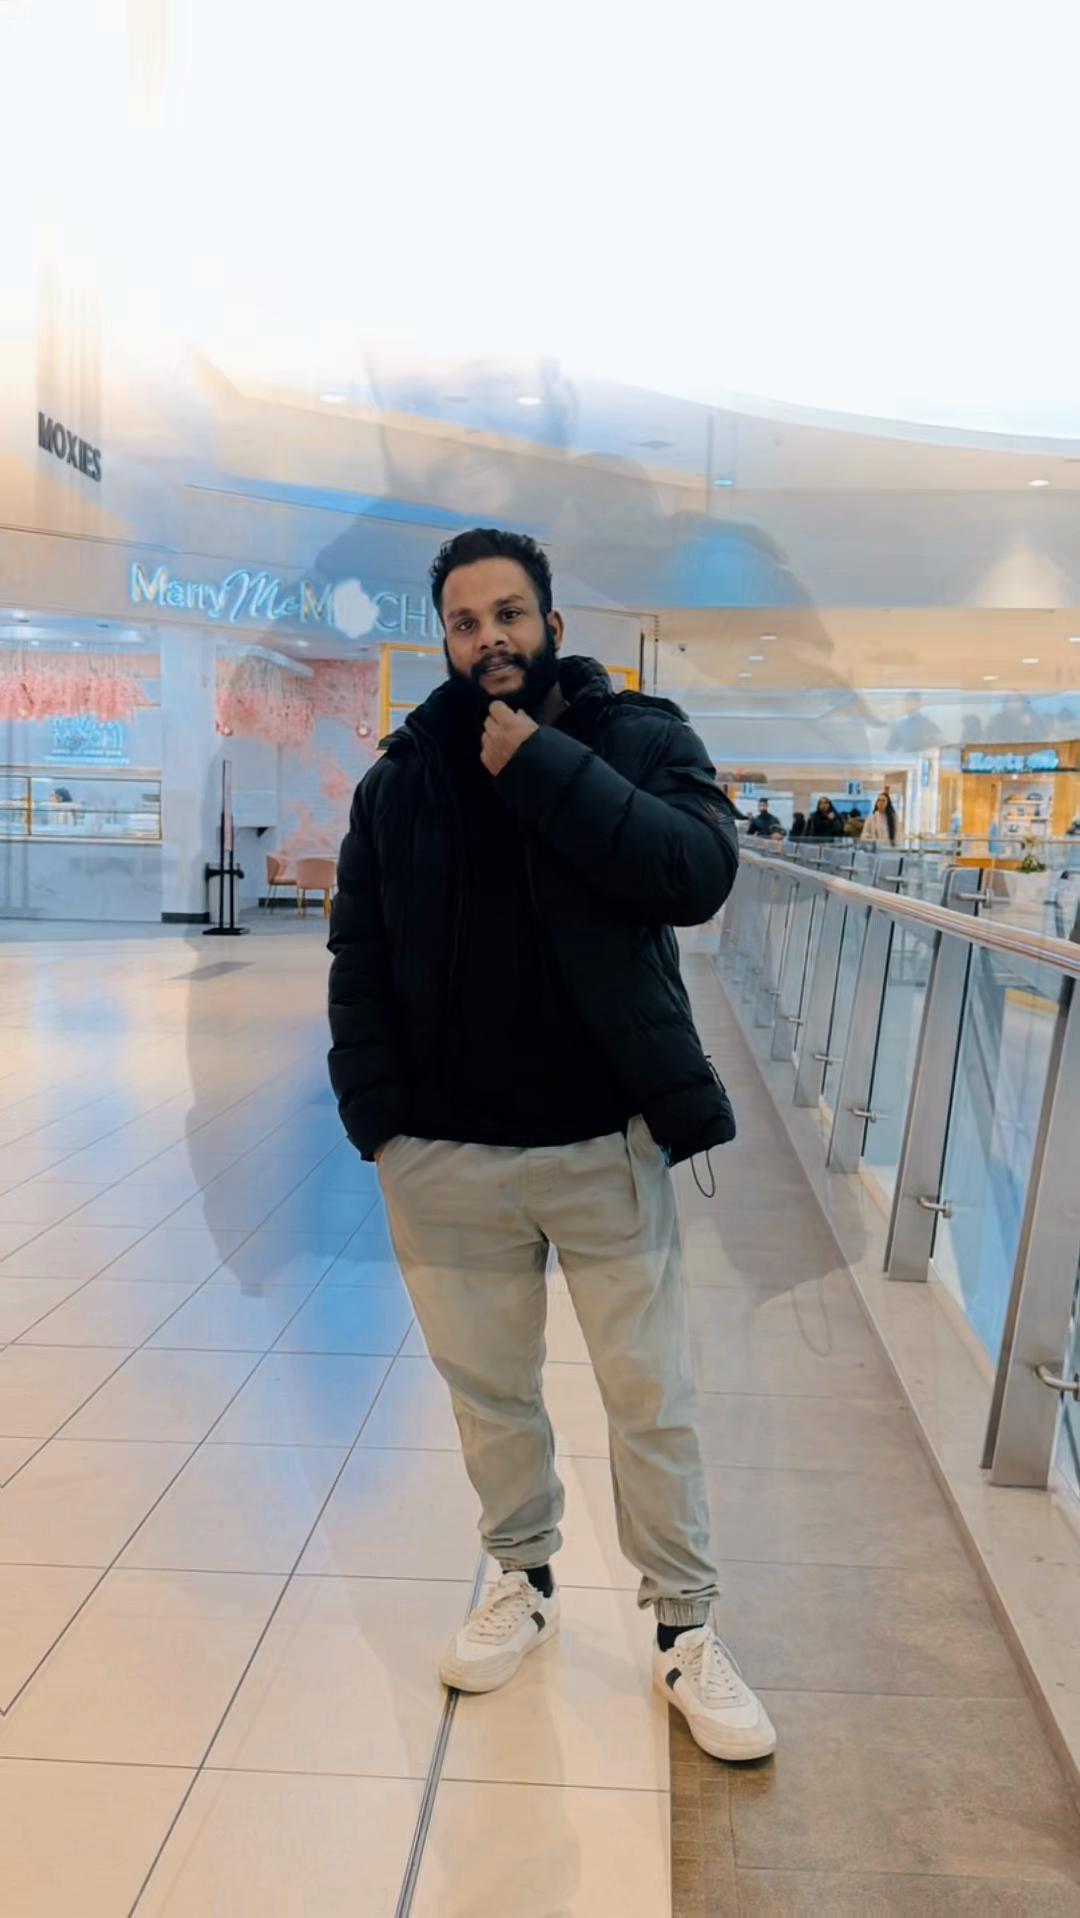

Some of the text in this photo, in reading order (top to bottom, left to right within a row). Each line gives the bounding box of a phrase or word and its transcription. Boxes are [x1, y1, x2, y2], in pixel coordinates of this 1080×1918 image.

[38, 411, 102, 482] MOXIES
[131, 562, 226, 618] Marry
[222, 569, 300, 623] Me
